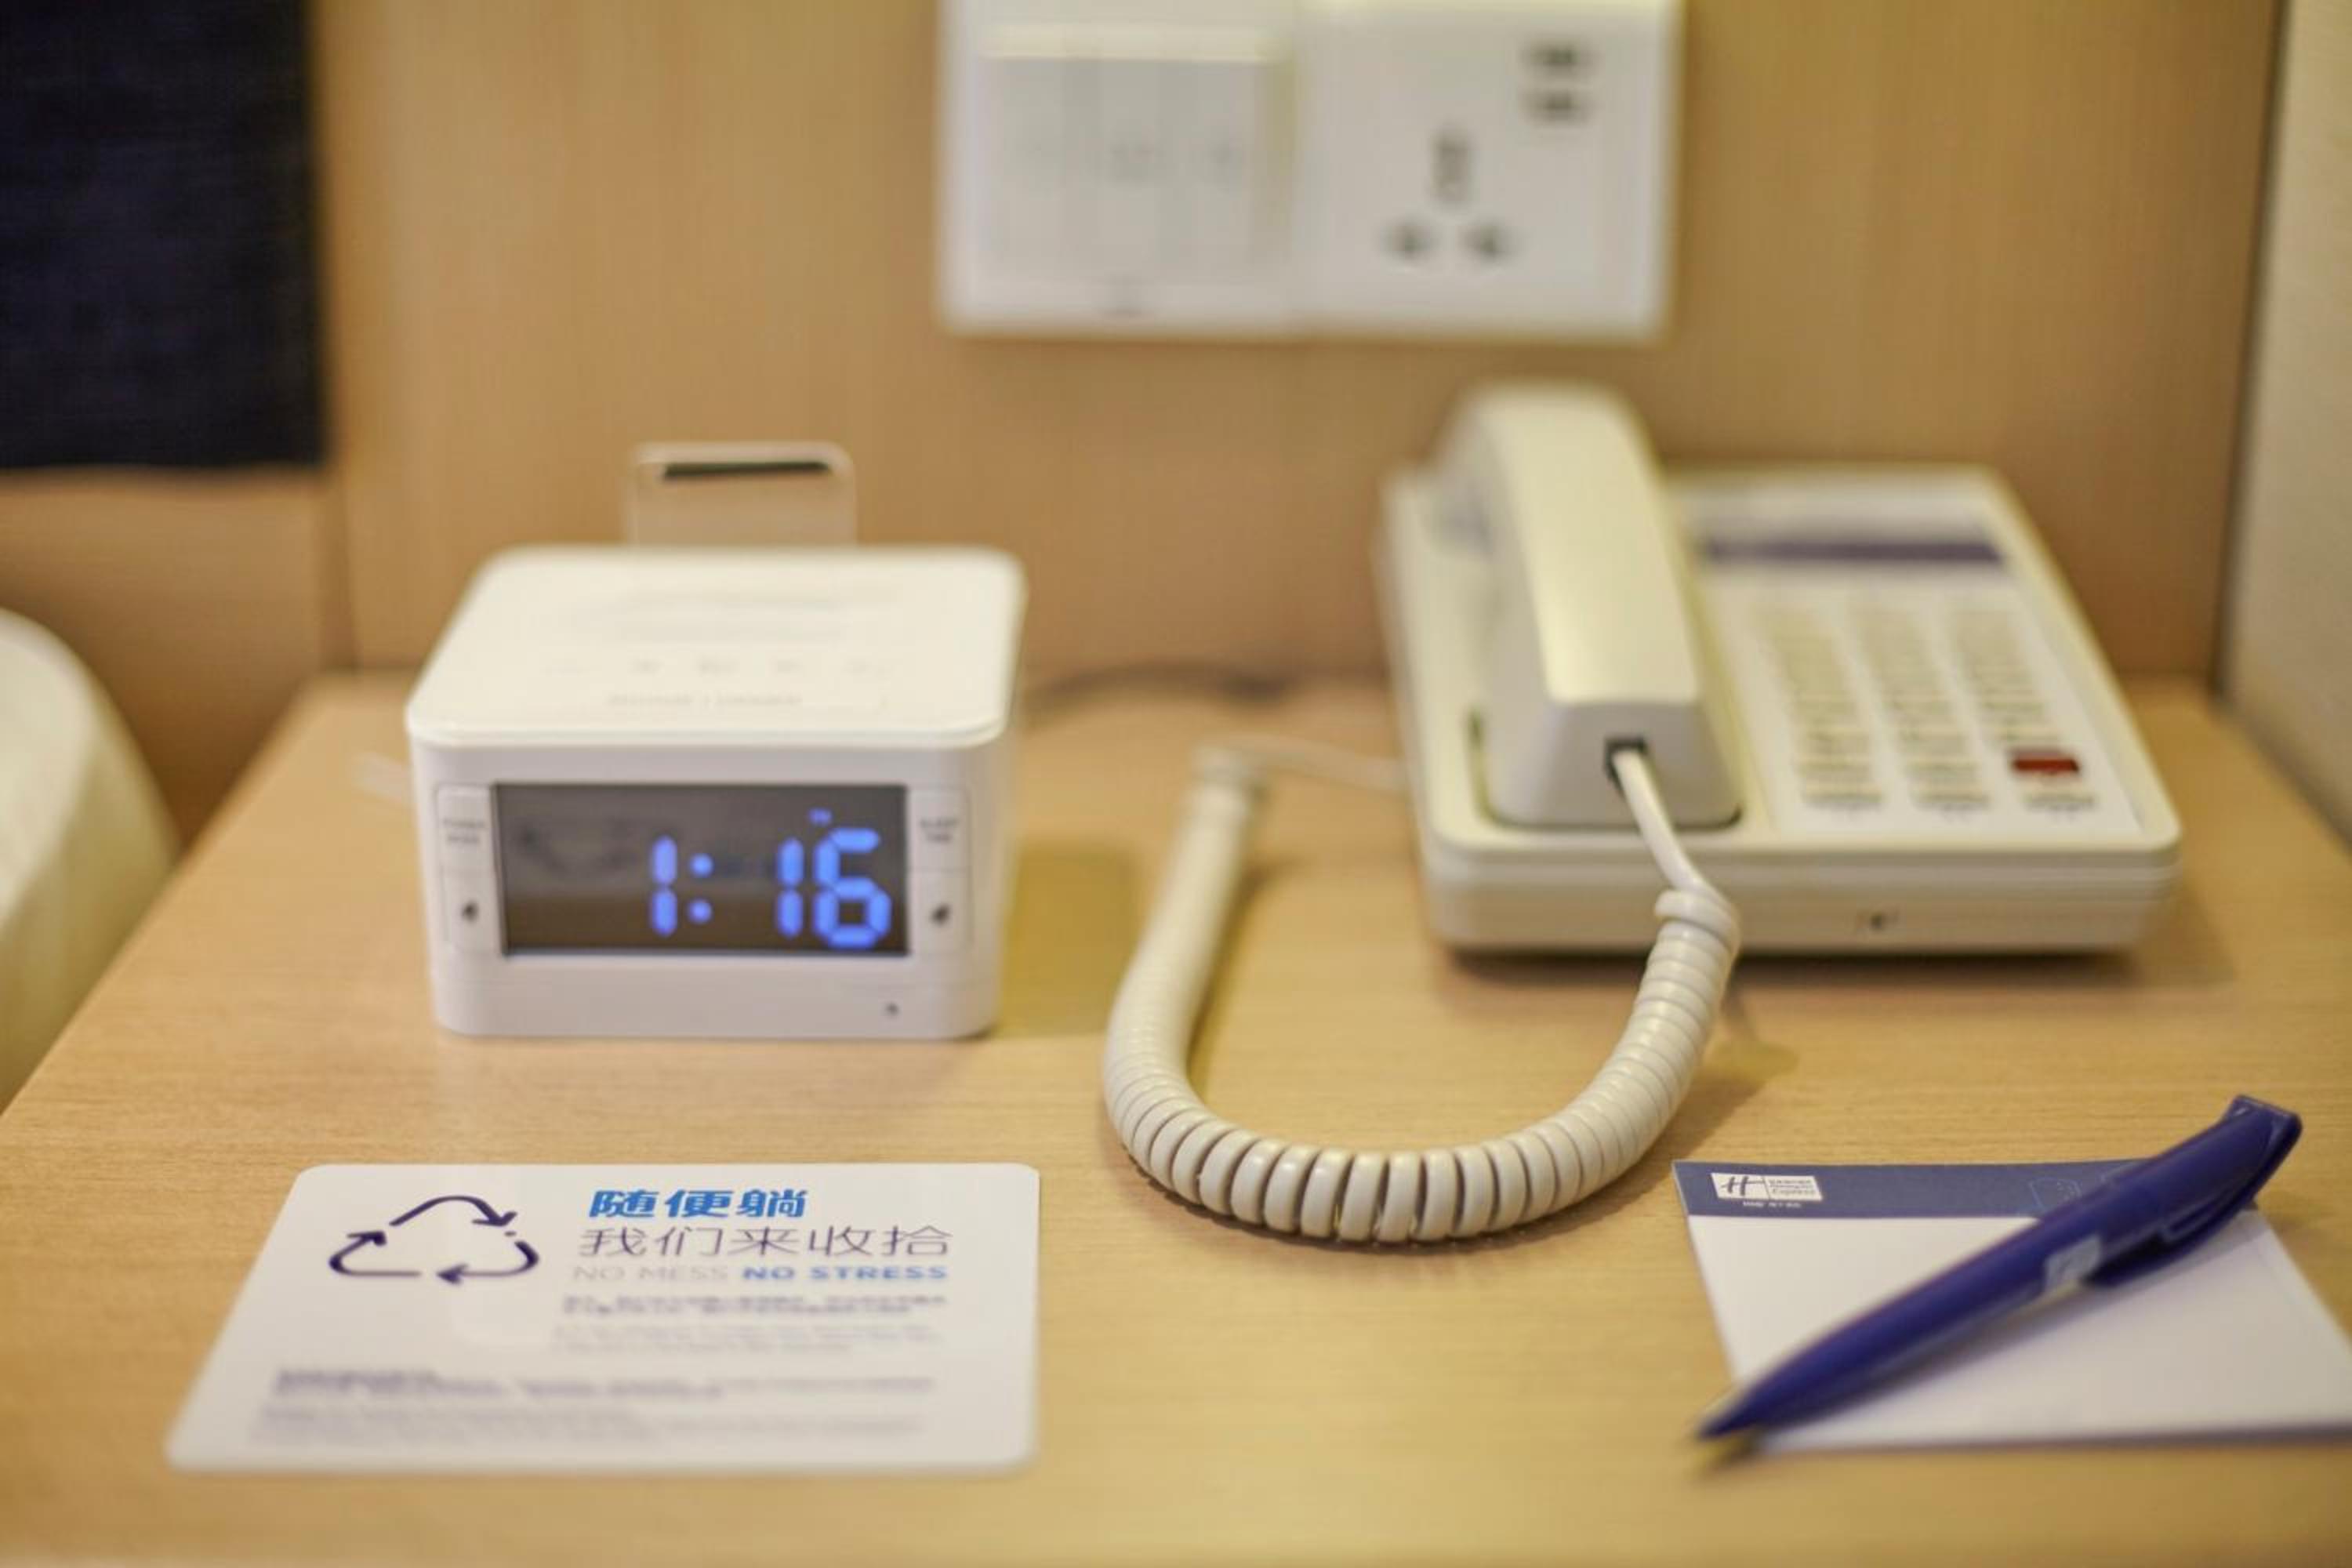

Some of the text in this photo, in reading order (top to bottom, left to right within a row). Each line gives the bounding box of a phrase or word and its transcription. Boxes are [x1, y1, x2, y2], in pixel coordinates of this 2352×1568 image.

[650, 827, 892, 949] 1:16
[588, 1189, 809, 1218] 随便躺
[578, 1225, 953, 1257] 我们来收拾
[572, 1265, 949, 1281] NO MESS NO STRESS
